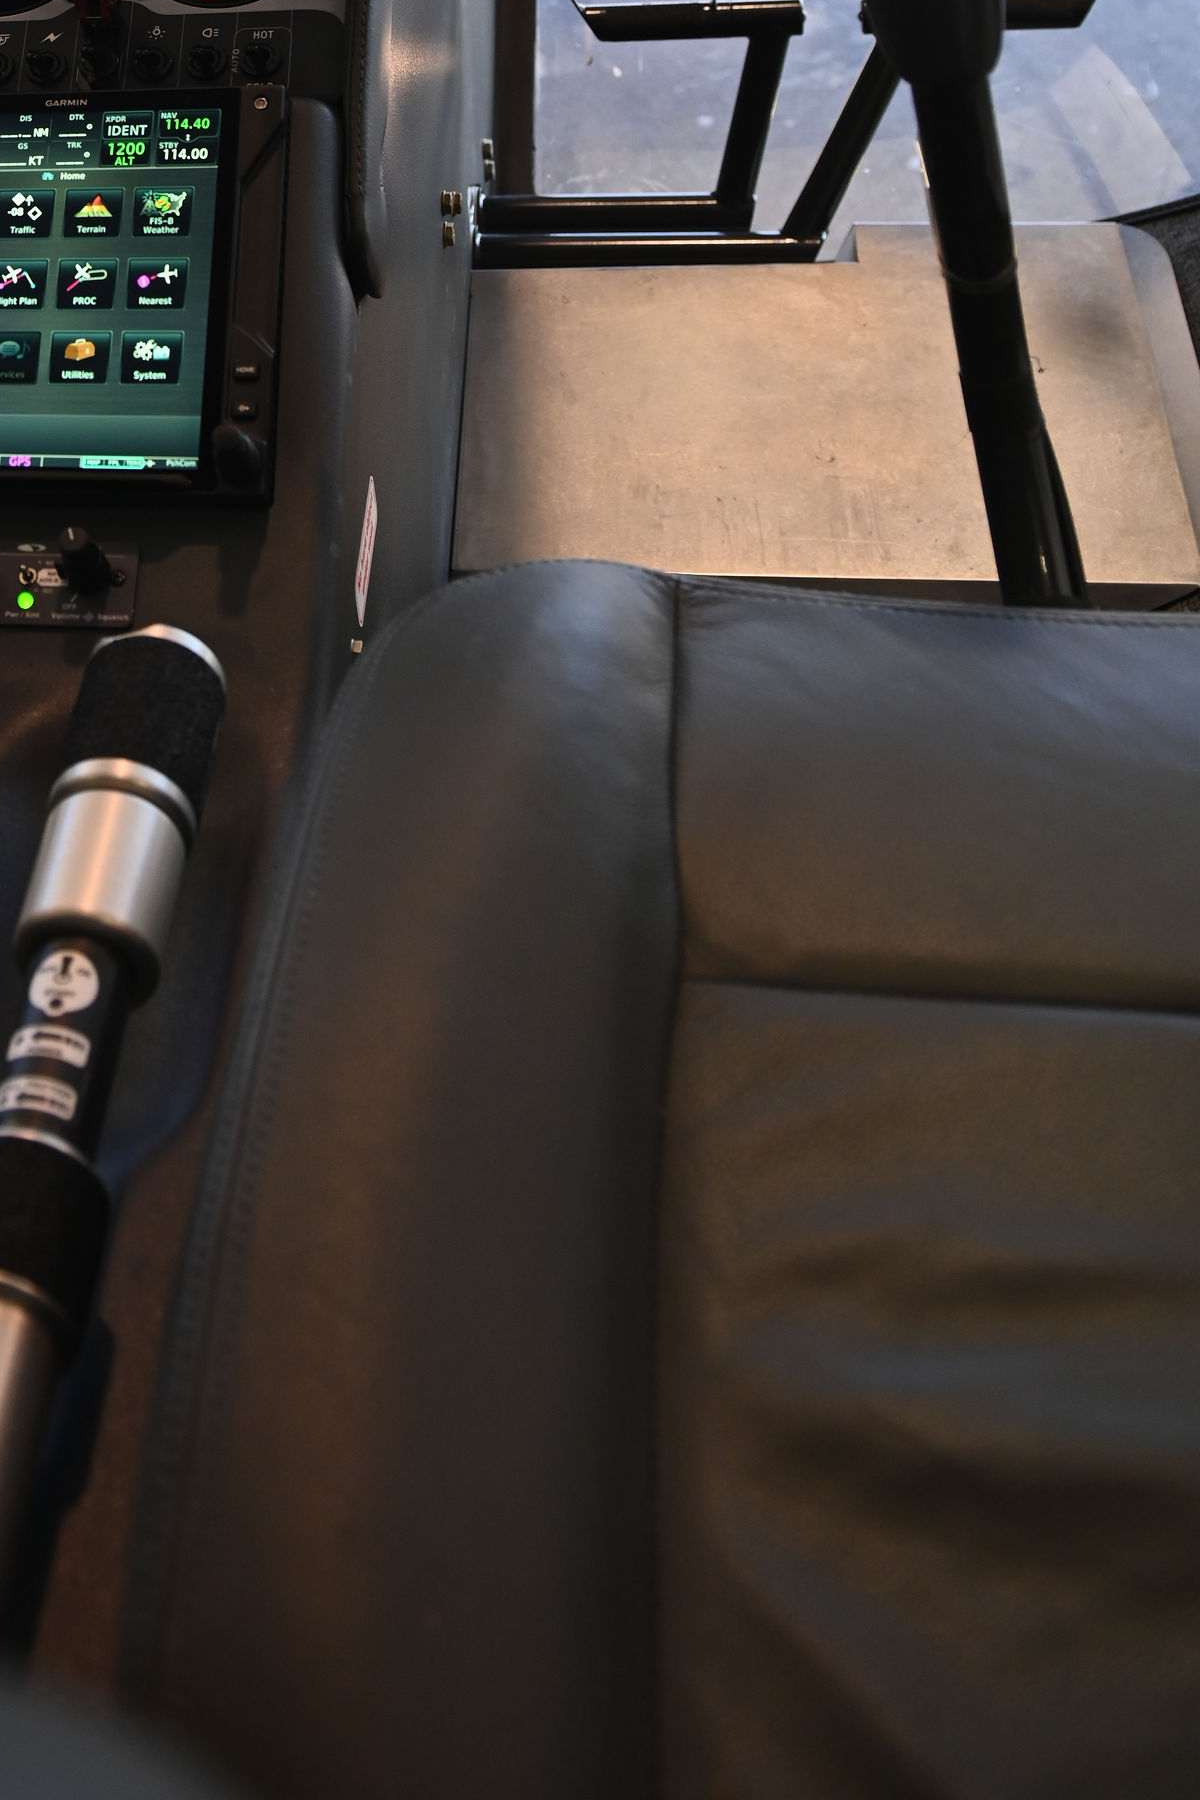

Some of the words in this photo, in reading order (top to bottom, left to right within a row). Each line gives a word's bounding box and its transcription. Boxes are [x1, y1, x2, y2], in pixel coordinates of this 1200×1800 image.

[253, 30, 274, 39] HOT
[232, 48, 240, 73] AUTO
[45, 98, 88, 107] GARMIN
[165, 118, 210, 130] 114.40
[33, 128, 49, 138] NM
[107, 124, 148, 137] IDENT
[108, 142, 145, 156] 1200
[163, 148, 208, 160] 114.00
[28, 156, 44, 166] KT
[114, 156, 135, 166] ALT
[60, 172, 86, 181] Home
[9, 225, 36, 234] Traffic
[76, 225, 107, 234] Terrain
[143, 225, 180, 234] Weather
[19, 297, 38, 306] Plan
[73, 297, 97, 305] PROC
[139, 296, 173, 306] Nearest
[61, 370, 95, 380] Utilities
[133, 371, 167, 381] System
[9, 456, 31, 467] GPS
[50, 612, 80, 621] Volume
